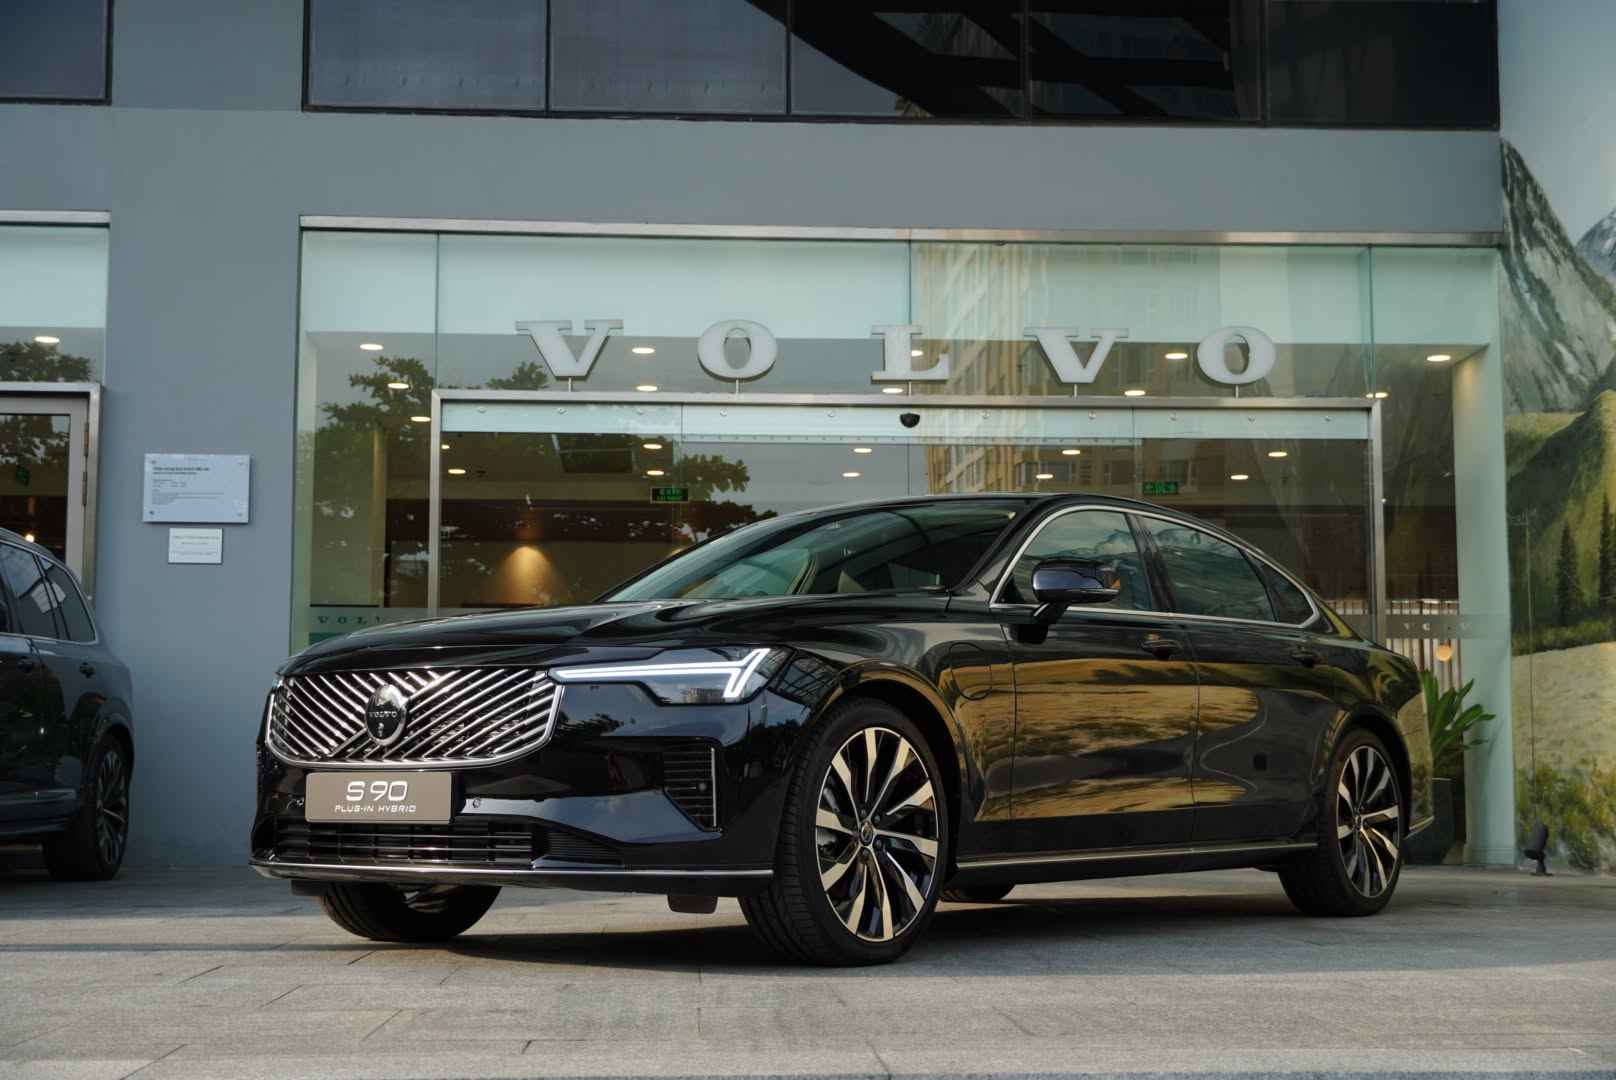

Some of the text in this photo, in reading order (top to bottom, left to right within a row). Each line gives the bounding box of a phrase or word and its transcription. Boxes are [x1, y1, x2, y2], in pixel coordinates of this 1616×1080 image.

[515, 318, 1277, 385] VOLVO
[346, 780, 408, 801] S90
[334, 804, 417, 813] PLUG-IN HYBRID
